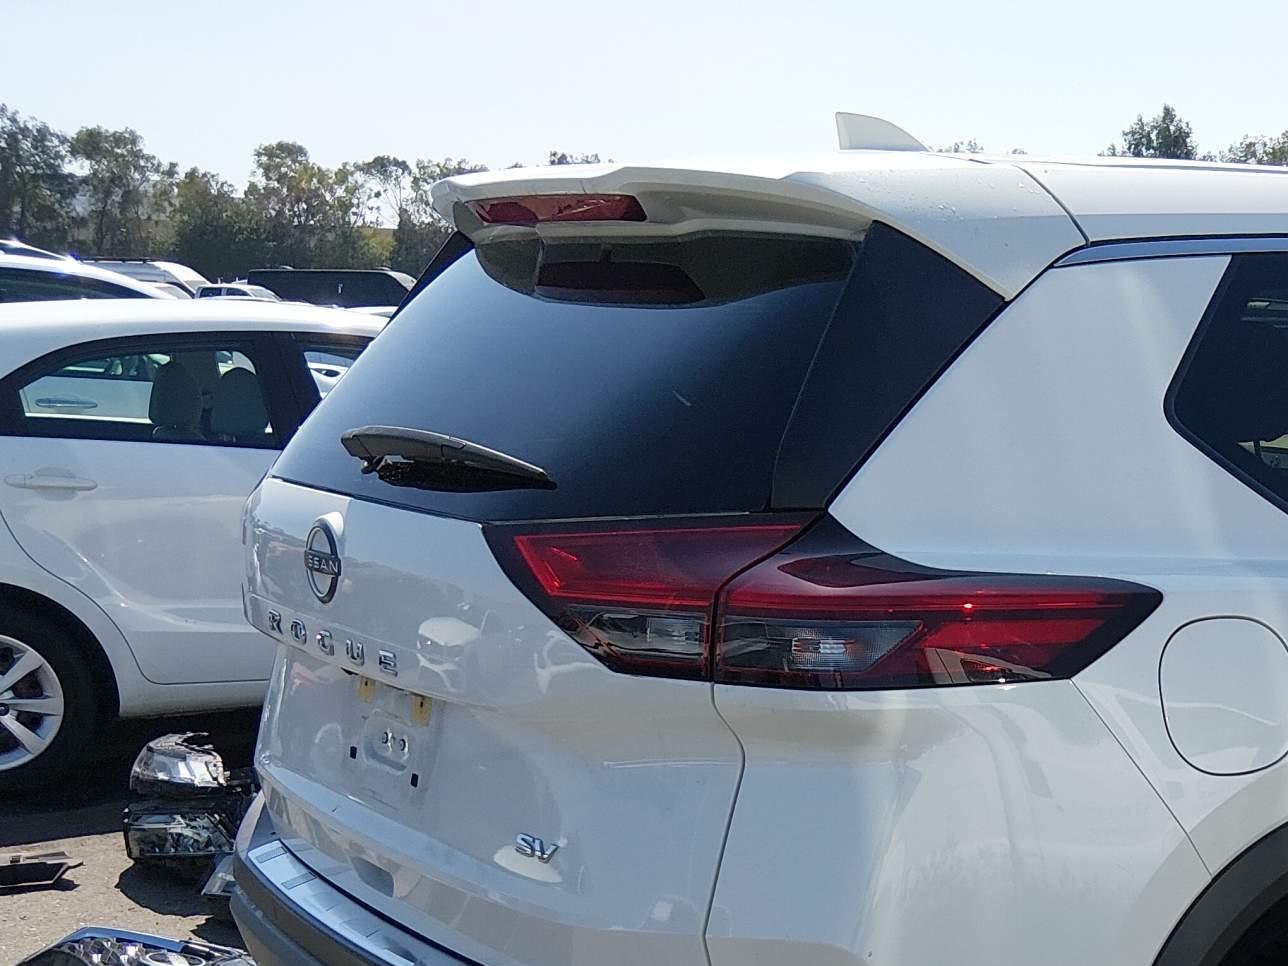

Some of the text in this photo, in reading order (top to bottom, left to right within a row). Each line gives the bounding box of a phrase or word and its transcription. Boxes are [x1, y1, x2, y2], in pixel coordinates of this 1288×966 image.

[306, 552, 338, 574] SSAN
[267, 608, 399, 678] ROGUE
[514, 832, 561, 865] SV
